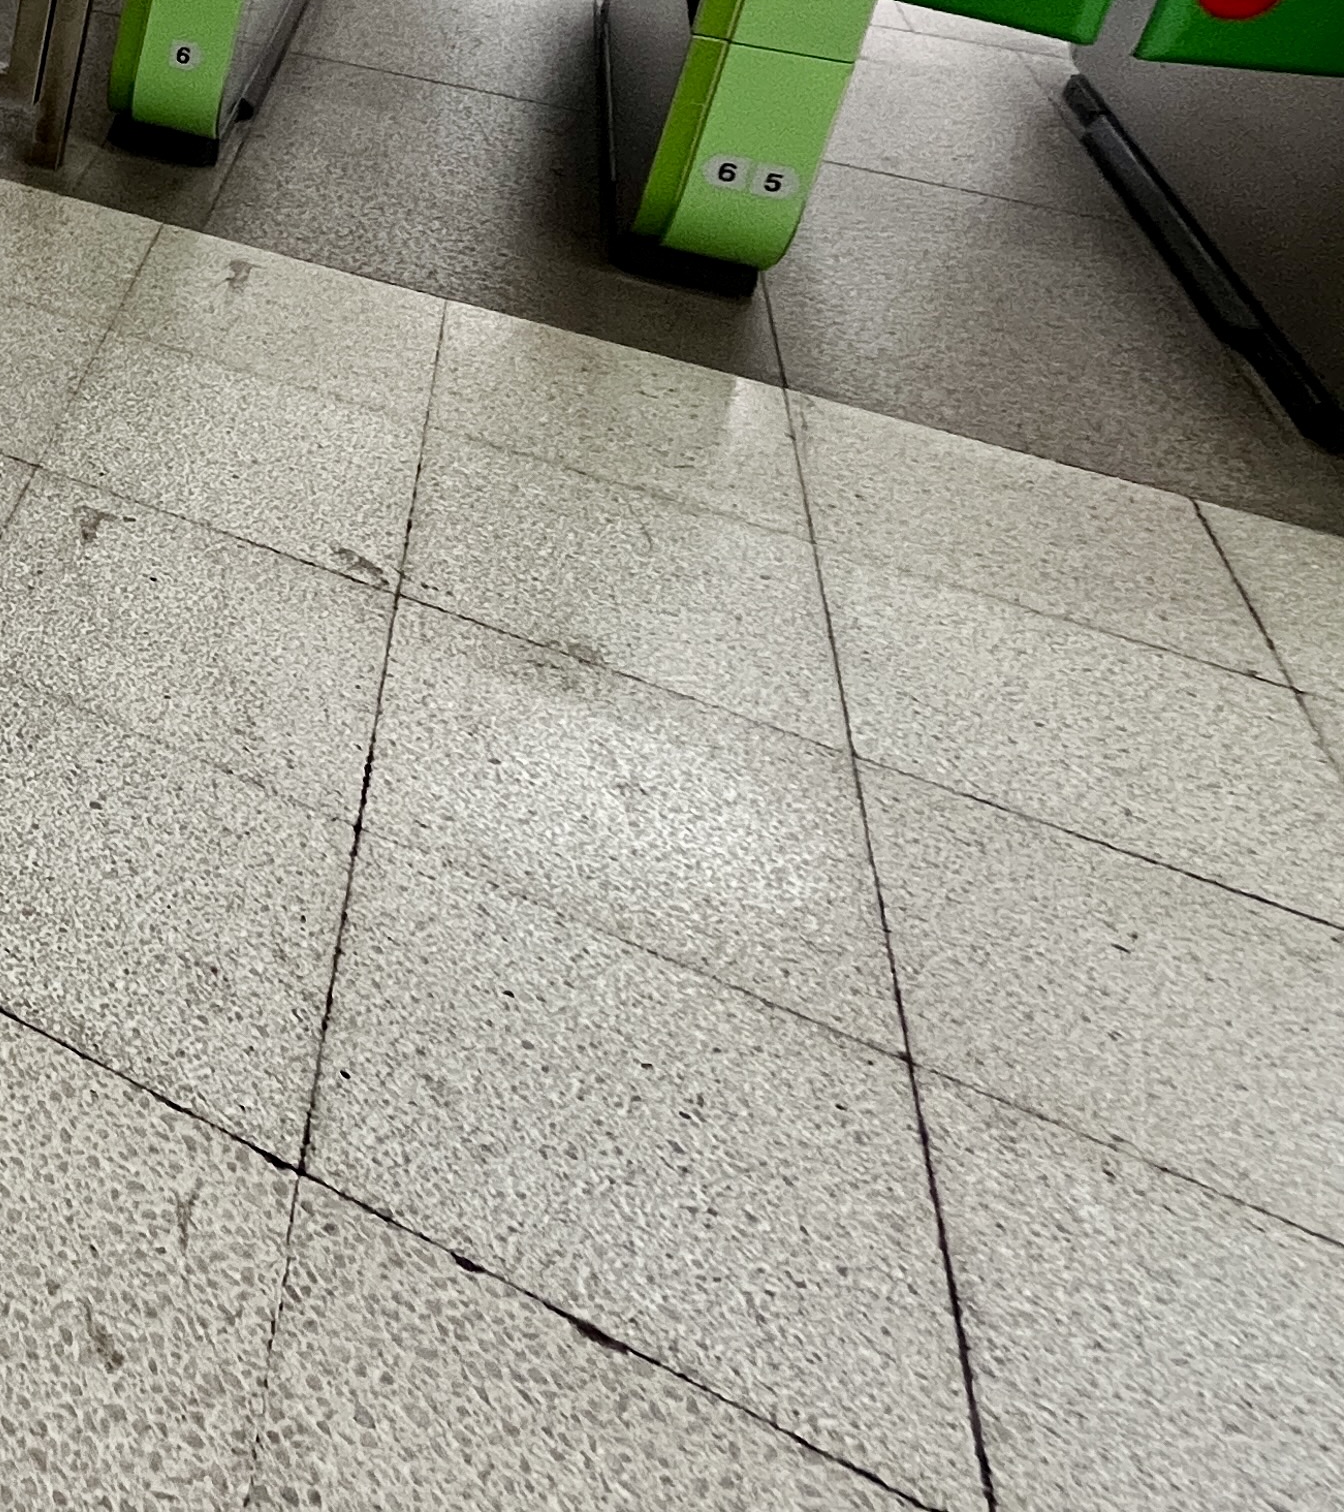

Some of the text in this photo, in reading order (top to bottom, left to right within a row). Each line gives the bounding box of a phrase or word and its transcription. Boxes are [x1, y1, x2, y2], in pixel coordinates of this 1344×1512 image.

[176, 46, 191, 65] 6
[717, 162, 785, 193] 6 5
